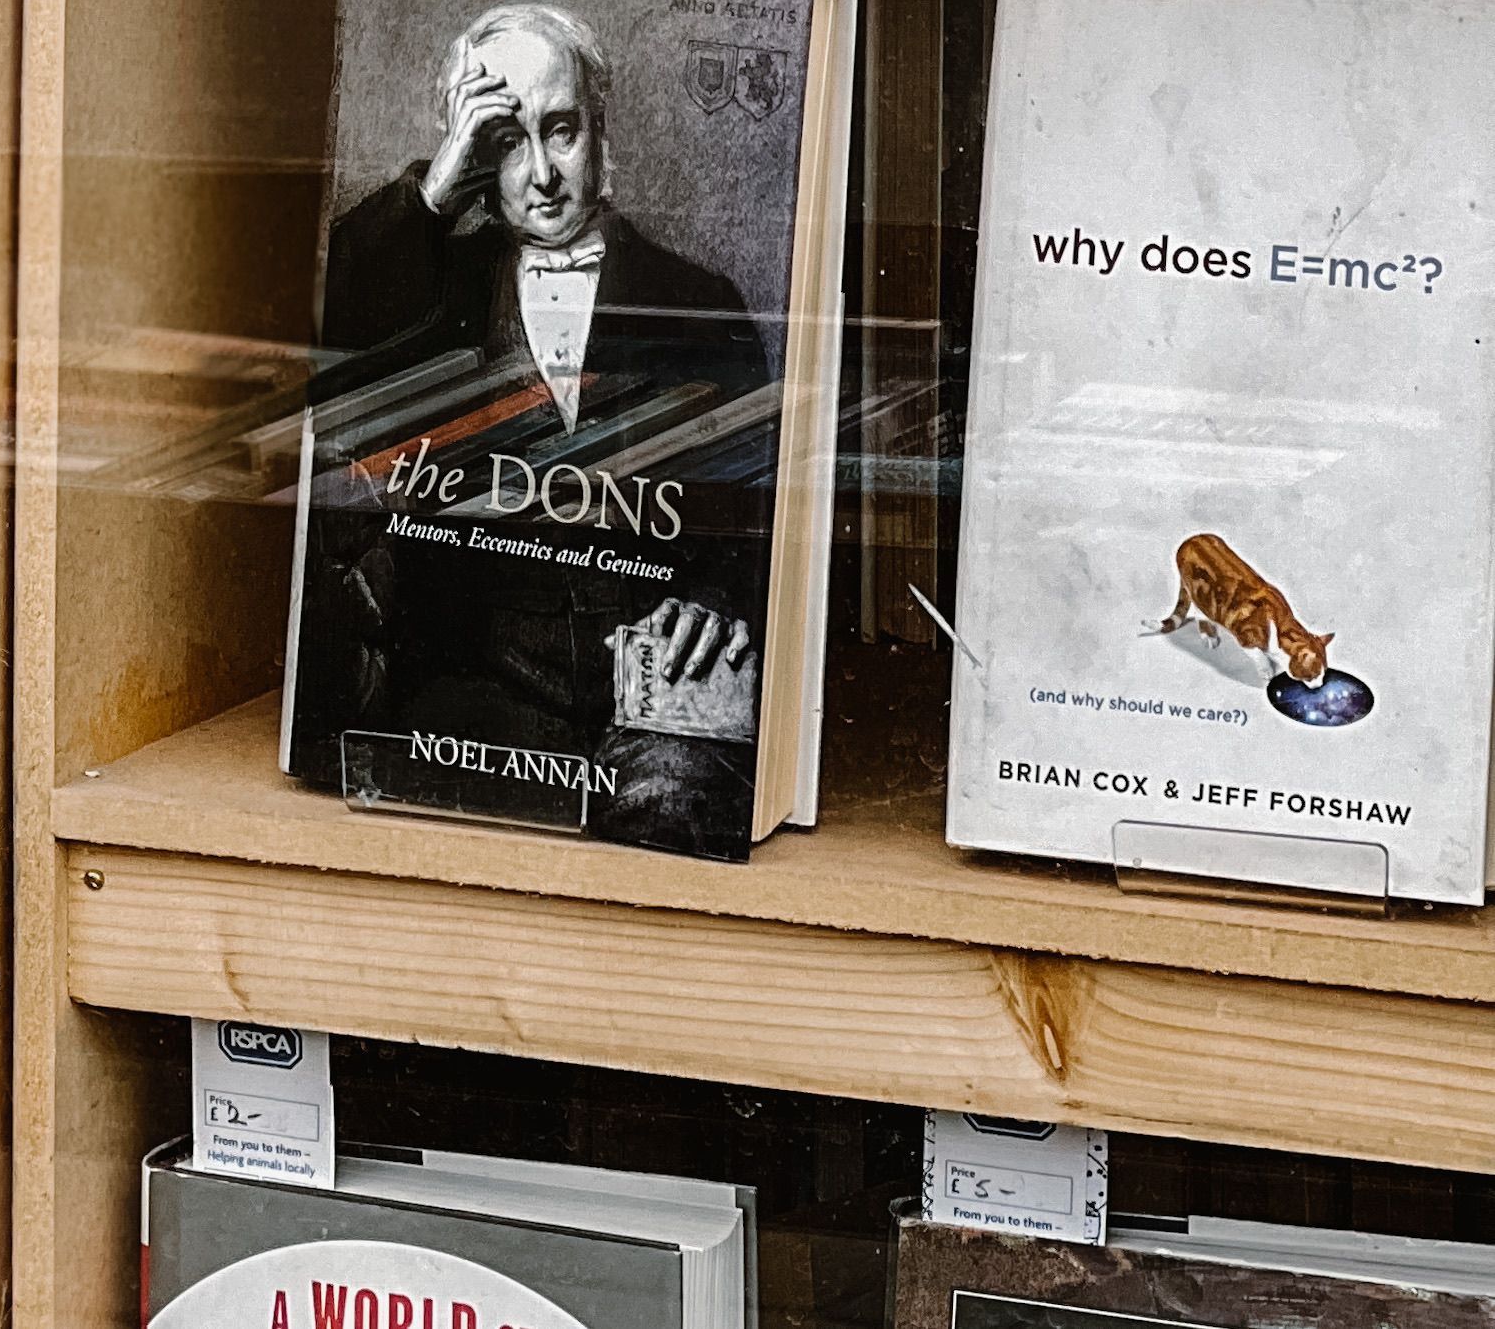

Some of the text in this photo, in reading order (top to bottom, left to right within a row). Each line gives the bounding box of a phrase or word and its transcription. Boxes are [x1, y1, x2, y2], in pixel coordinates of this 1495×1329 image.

[1032, 228, 1125, 275] why
[1141, 235, 1252, 279] does
[386, 438, 683, 542] the DONS
[386, 512, 674, 582] Mentors, Eccentrics and Geniuses
[1029, 687, 1248, 727] (and why should we care?)
[409, 730, 619, 797] NOEL ANNAN
[998, 760, 1412, 826] BRIAN COX & JEFF FORSHAW
